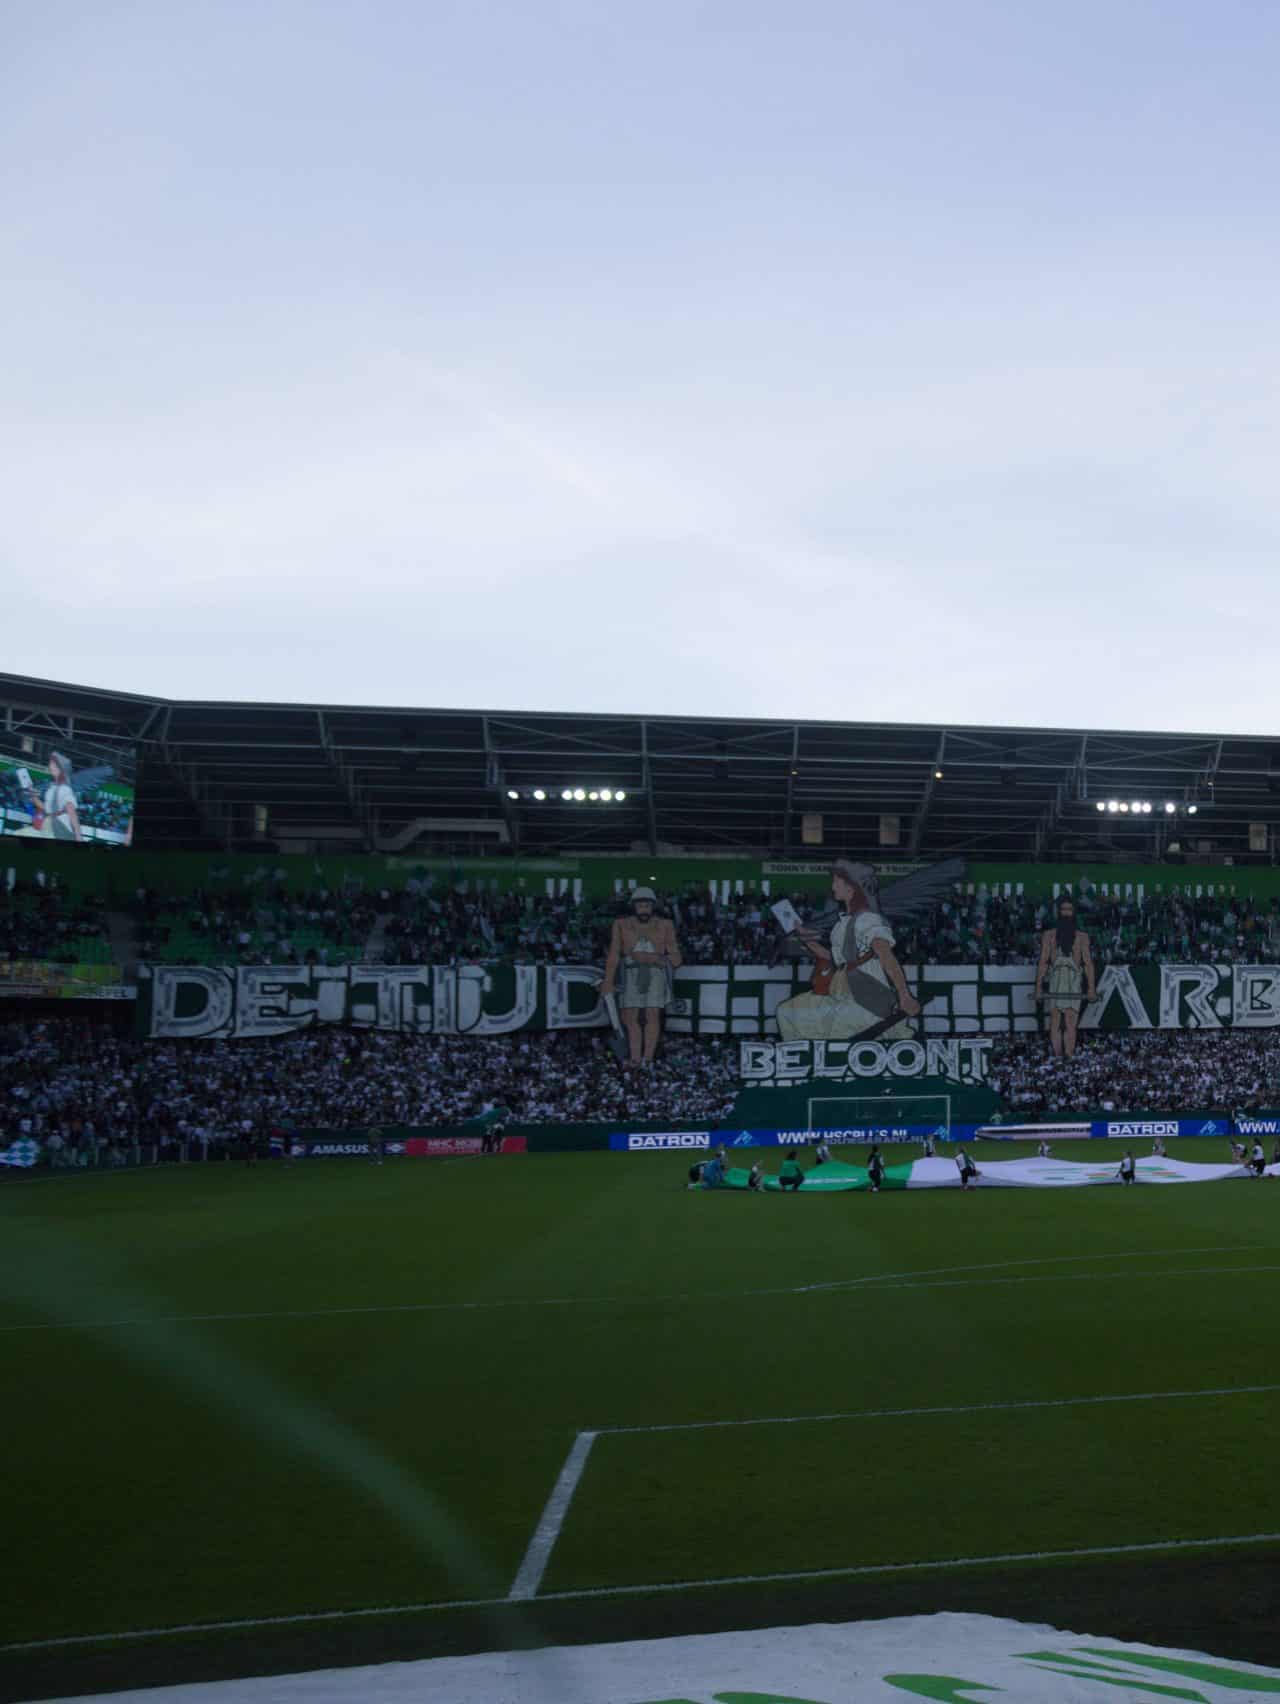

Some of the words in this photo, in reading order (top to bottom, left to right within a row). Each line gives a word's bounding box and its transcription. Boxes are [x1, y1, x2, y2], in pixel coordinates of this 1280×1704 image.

[740, 1039, 993, 1082] BELOONT
[1107, 1123, 1179, 1136] DATRON
[628, 1135, 710, 1148] DATRON
[311, 1144, 369, 1155] AMASUS
